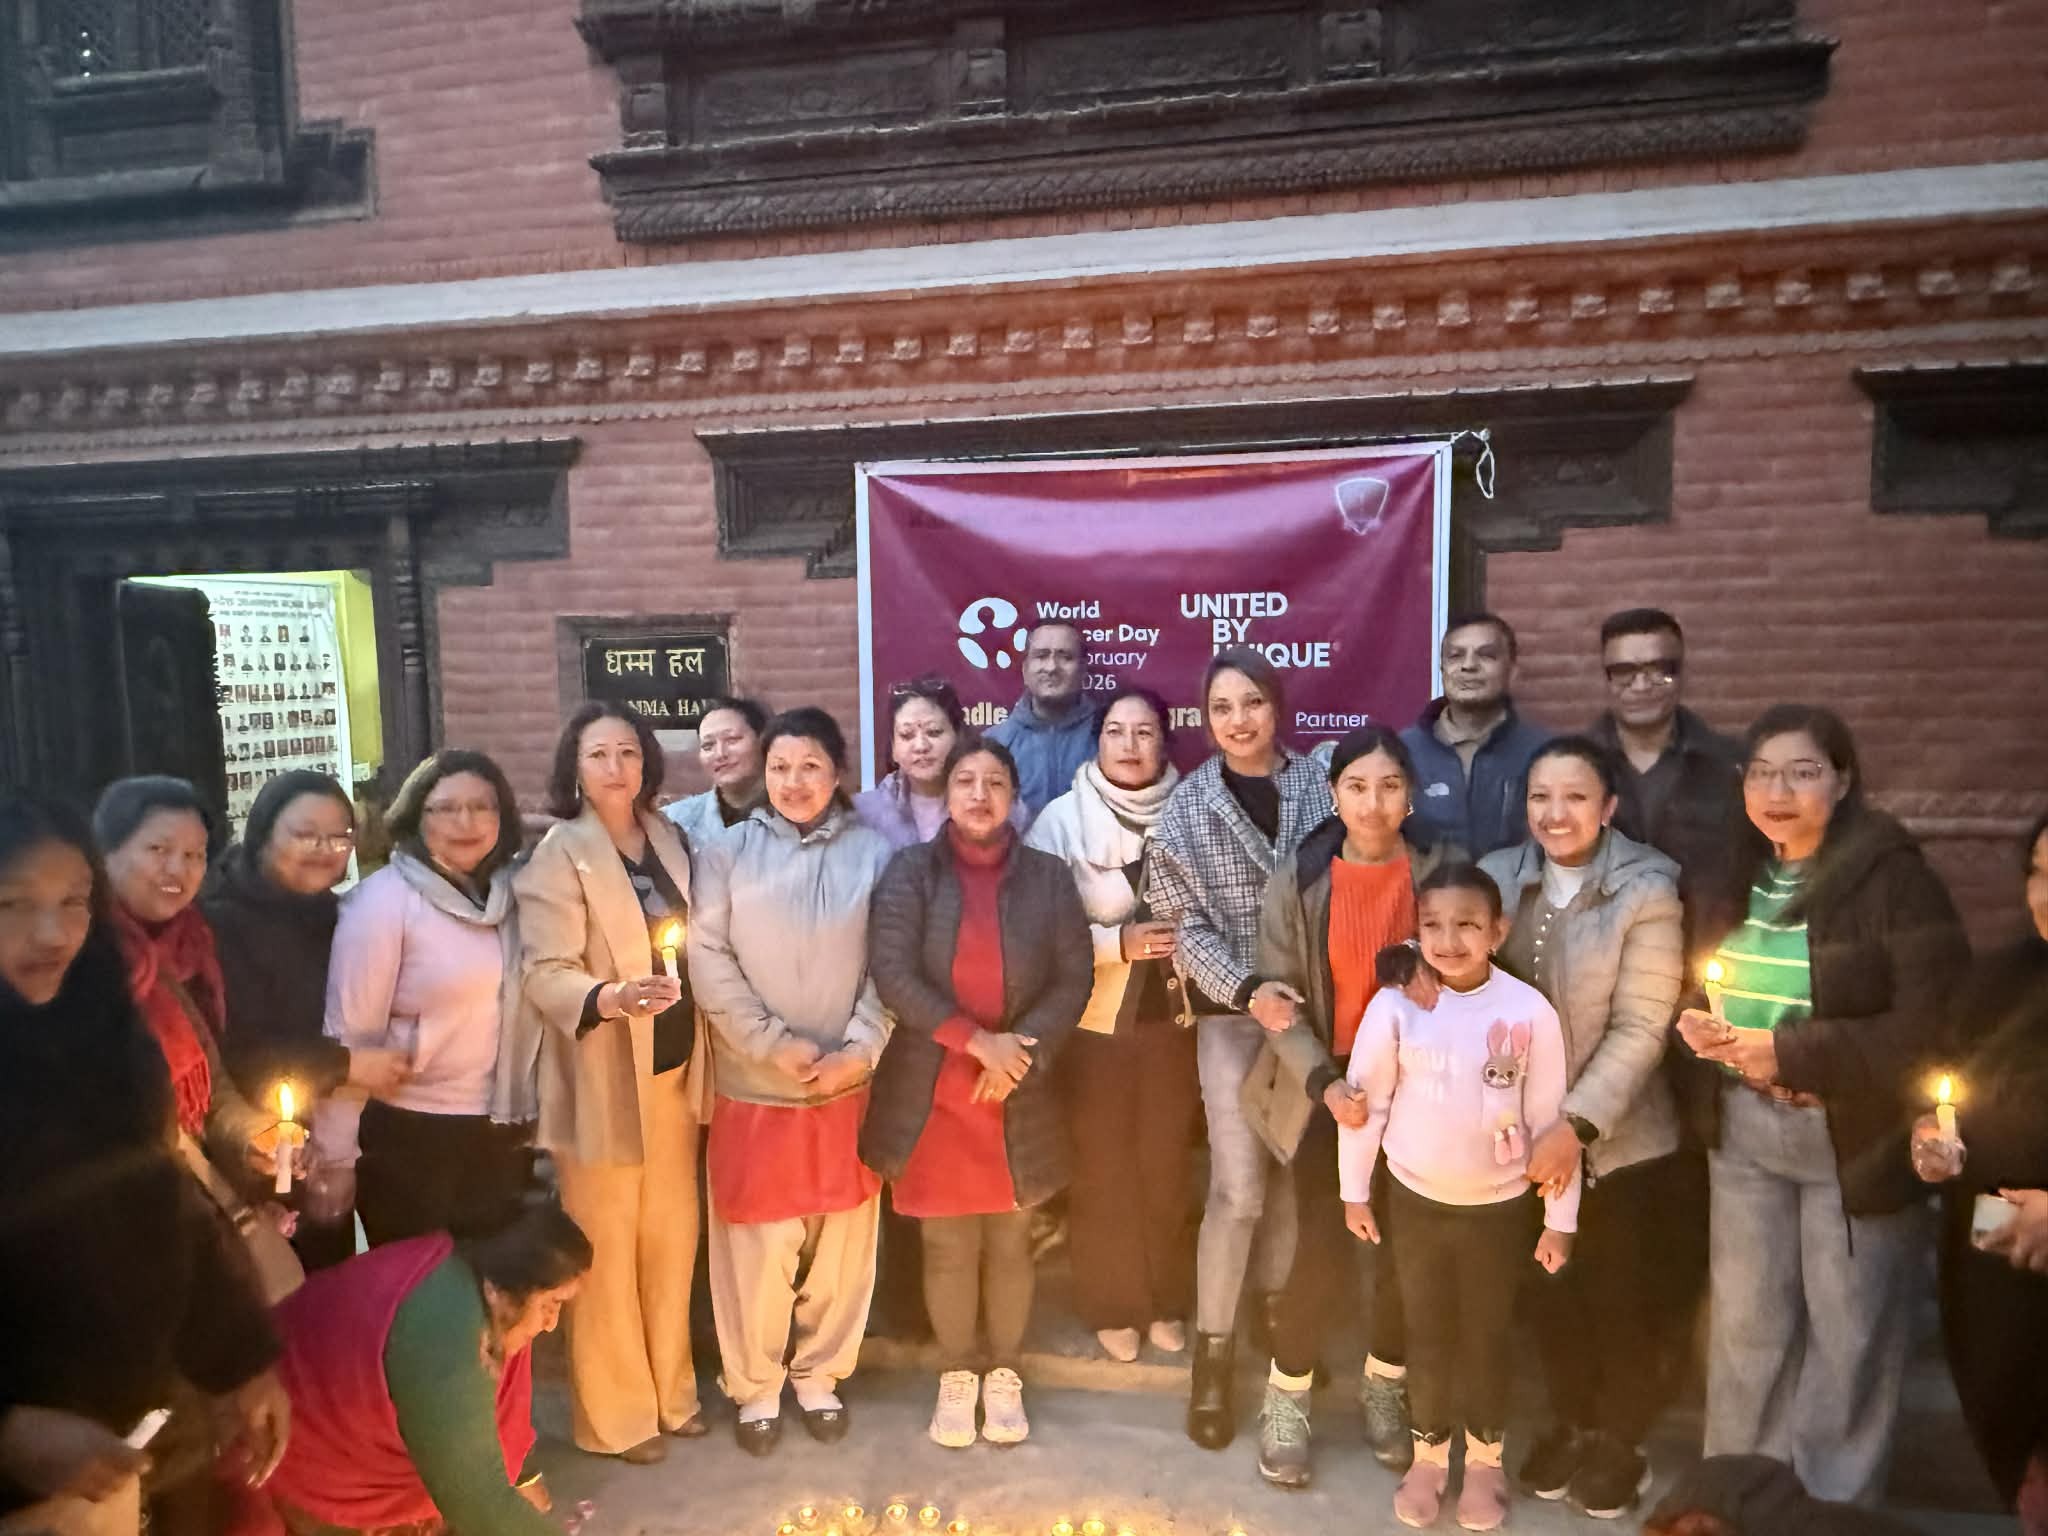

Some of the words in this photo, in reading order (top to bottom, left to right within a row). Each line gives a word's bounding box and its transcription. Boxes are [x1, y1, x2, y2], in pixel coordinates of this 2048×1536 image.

[1036, 600, 1100, 619] World
[1180, 591, 1288, 619] UNITED
[1118, 624, 1160, 646] Day
[1212, 618, 1252, 643] BY
[1087, 652, 1147, 670] ruary
[1212, 642, 1331, 668] QUE
[1081, 674, 1117, 690] 026
[1295, 711, 1369, 728] Partner
